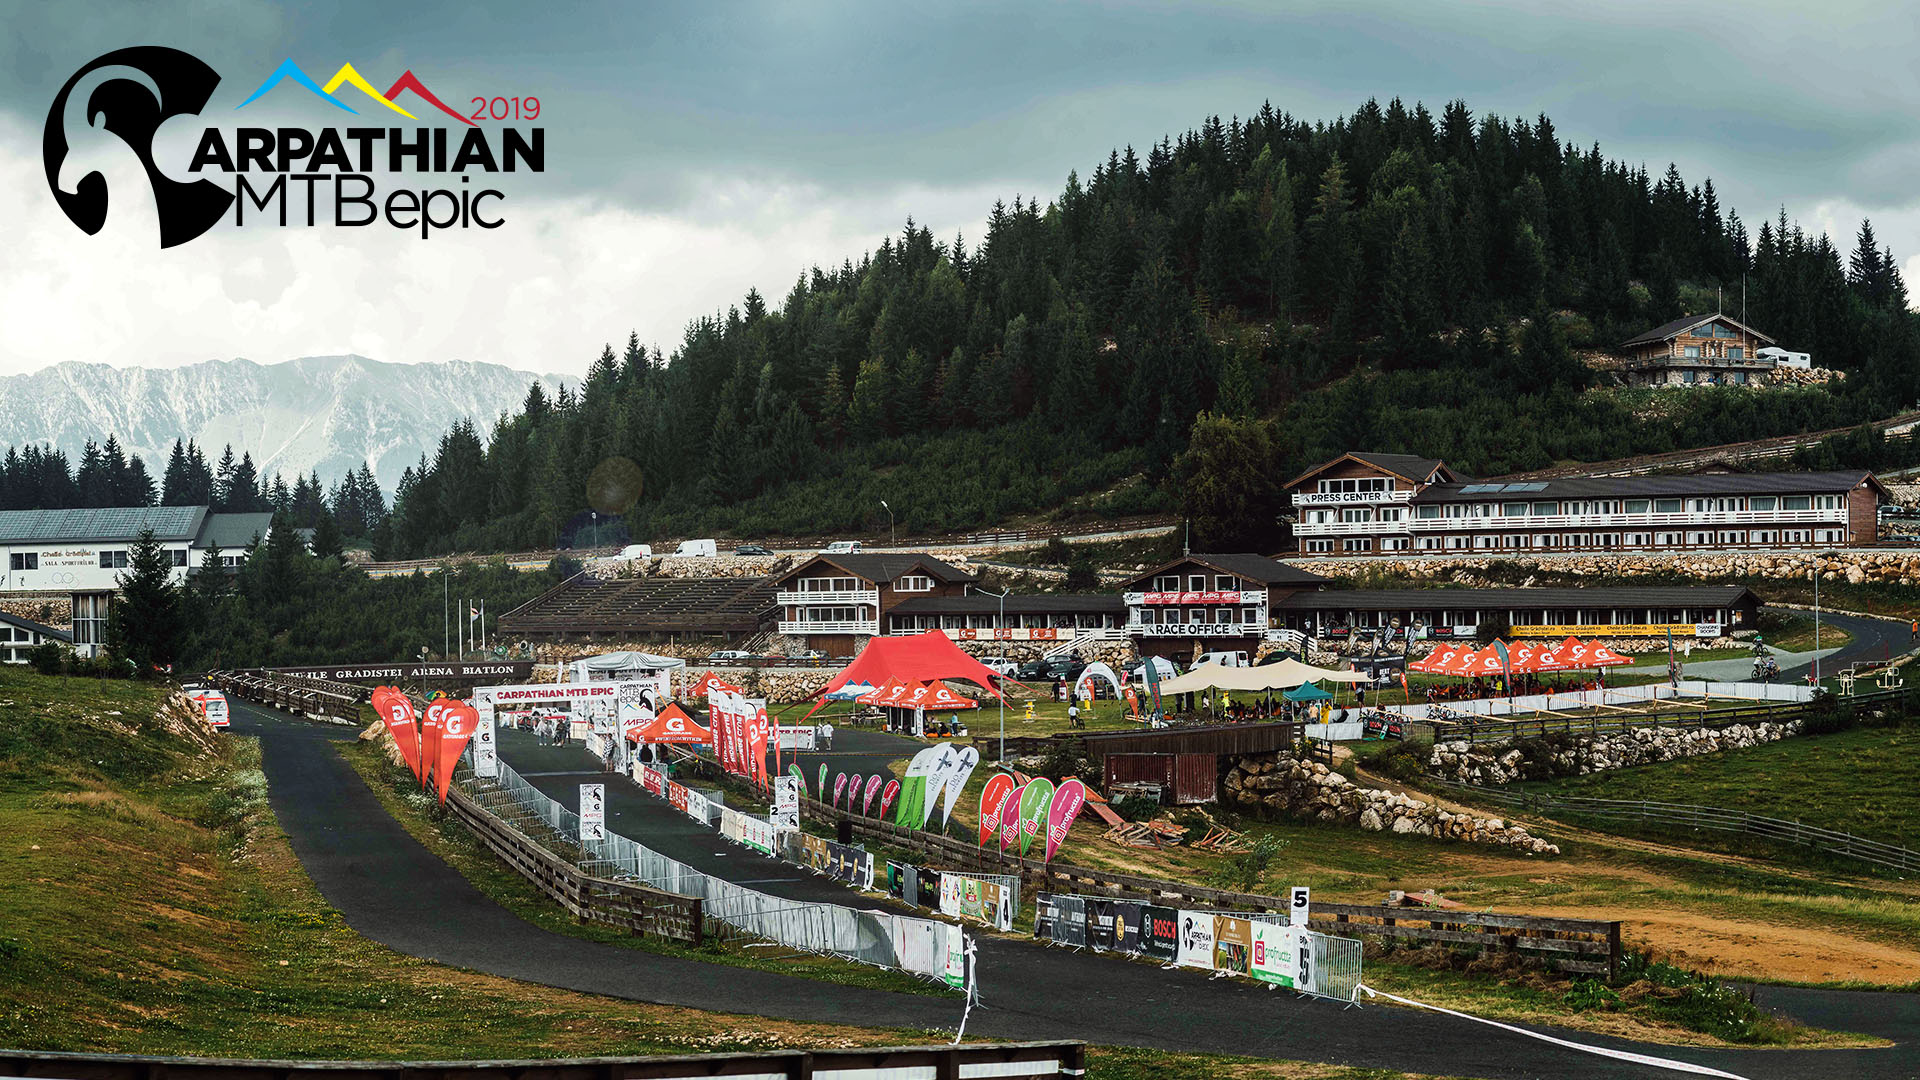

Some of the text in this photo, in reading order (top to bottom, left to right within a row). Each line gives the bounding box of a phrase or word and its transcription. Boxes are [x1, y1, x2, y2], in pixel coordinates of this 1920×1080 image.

[1311, 492, 1381, 502] PRESS CENTER
[1156, 624, 1230, 634] RACE OFFICE
[335, 668, 402, 679] GRADISTEI
[411, 667, 454, 676] ARENA
[462, 666, 515, 675] BIATLON
[496, 687, 614, 700] CARPATHIAN MTB EPIC
[771, 806, 778, 816] 2
[1293, 891, 1307, 908] 5
[1153, 918, 1176, 940] BOSCH
